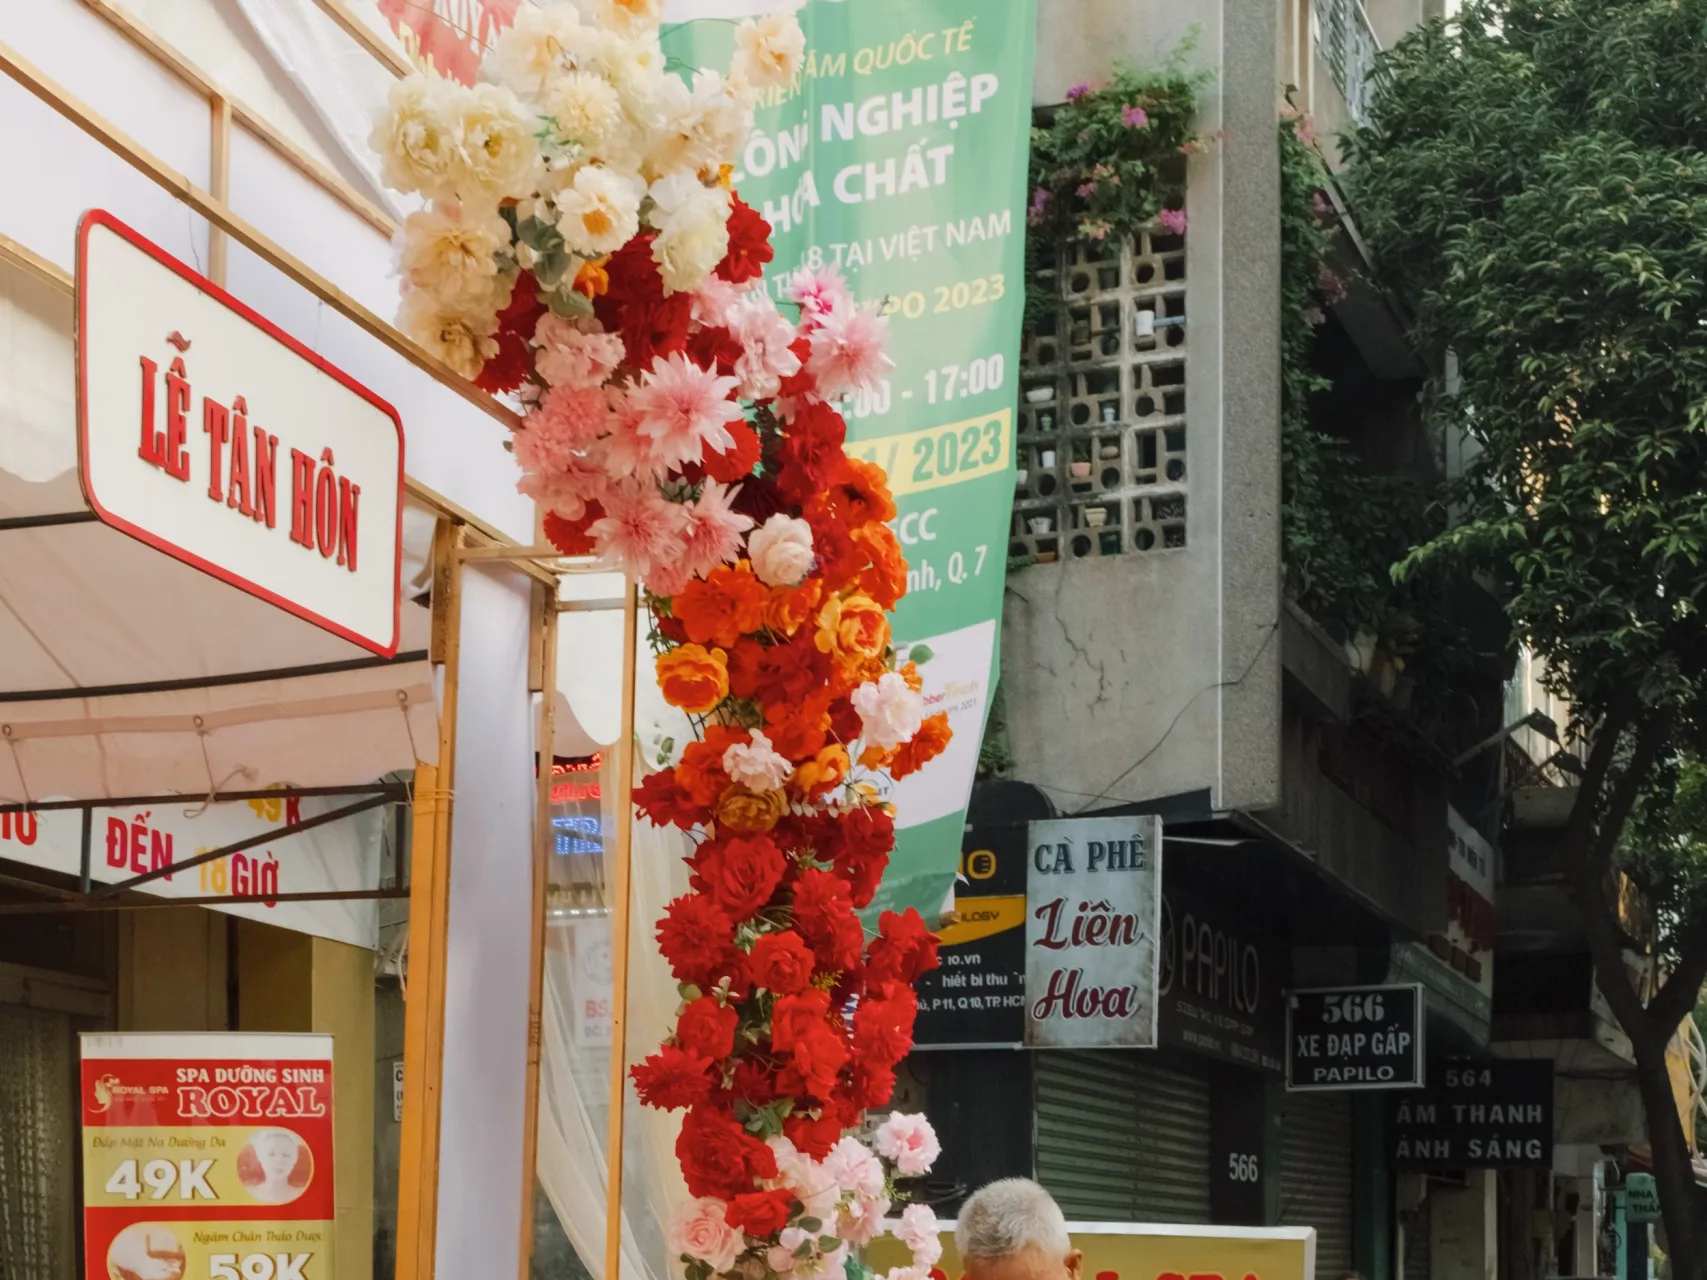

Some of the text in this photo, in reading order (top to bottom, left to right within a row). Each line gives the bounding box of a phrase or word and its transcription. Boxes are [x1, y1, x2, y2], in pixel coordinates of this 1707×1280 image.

[853, 28, 934, 75] QUỐC
[941, 16, 977, 55] TẾ
[820, 70, 999, 142] NGHIỆP
[833, 138, 955, 205] CHẤT
[830, 241, 873, 273] TẠI
[879, 220, 939, 265] VIỆT
[946, 210, 1011, 248] NAM
[934, 274, 1006, 313] 2023
[924, 353, 1004, 405] 17:00
[138, 329, 361, 573] LỄ TÂN HÔN
[912, 419, 1001, 484] 2023
[106, 810, 173, 881] ĐẾN
[1034, 834, 1146, 874] CÀ PHÊ
[1033, 897, 1144, 951] Liên
[1182, 912, 1260, 1015] PAPILO
[1031, 967, 1139, 1020] Hoa
[1323, 994, 1384, 1023] 566
[1297, 1023, 1411, 1060] XE ĐẠP GẤP
[176, 1065, 324, 1083] SPA DƯỠNG SINH
[1314, 1065, 1395, 1082] PAPILO
[1446, 1069, 1492, 1088] 564
[177, 1086, 326, 1118] ROYAL
[1396, 1100, 1543, 1124] ÂM THANH
[1229, 1152, 1259, 1182] 566
[1467, 1133, 1543, 1160] SÁNG
[105, 1158, 220, 1201] 49K
